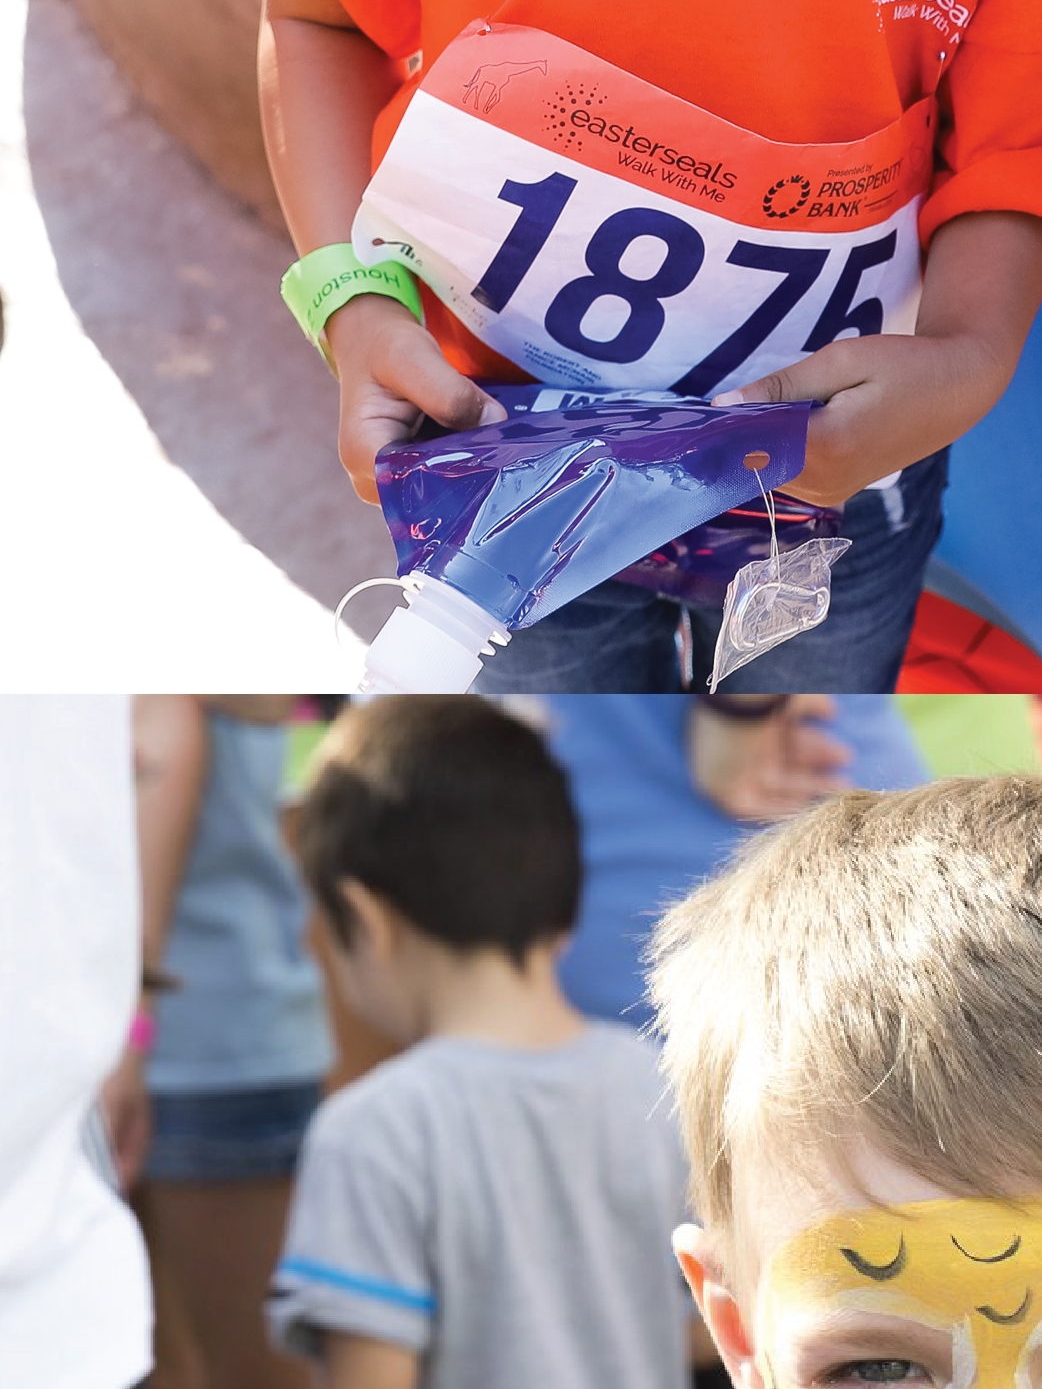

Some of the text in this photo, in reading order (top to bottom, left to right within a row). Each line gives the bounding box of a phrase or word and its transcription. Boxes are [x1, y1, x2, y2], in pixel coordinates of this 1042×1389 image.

[920, 5, 950, 36] With
[570, 109, 738, 189] easterseals
[618, 151, 726, 203] Walk With Me
[827, 163, 874, 178] Presented by
[807, 199, 862, 218] BANK
[312, 267, 400, 309] Houston
[470, 171, 898, 396] 1875
